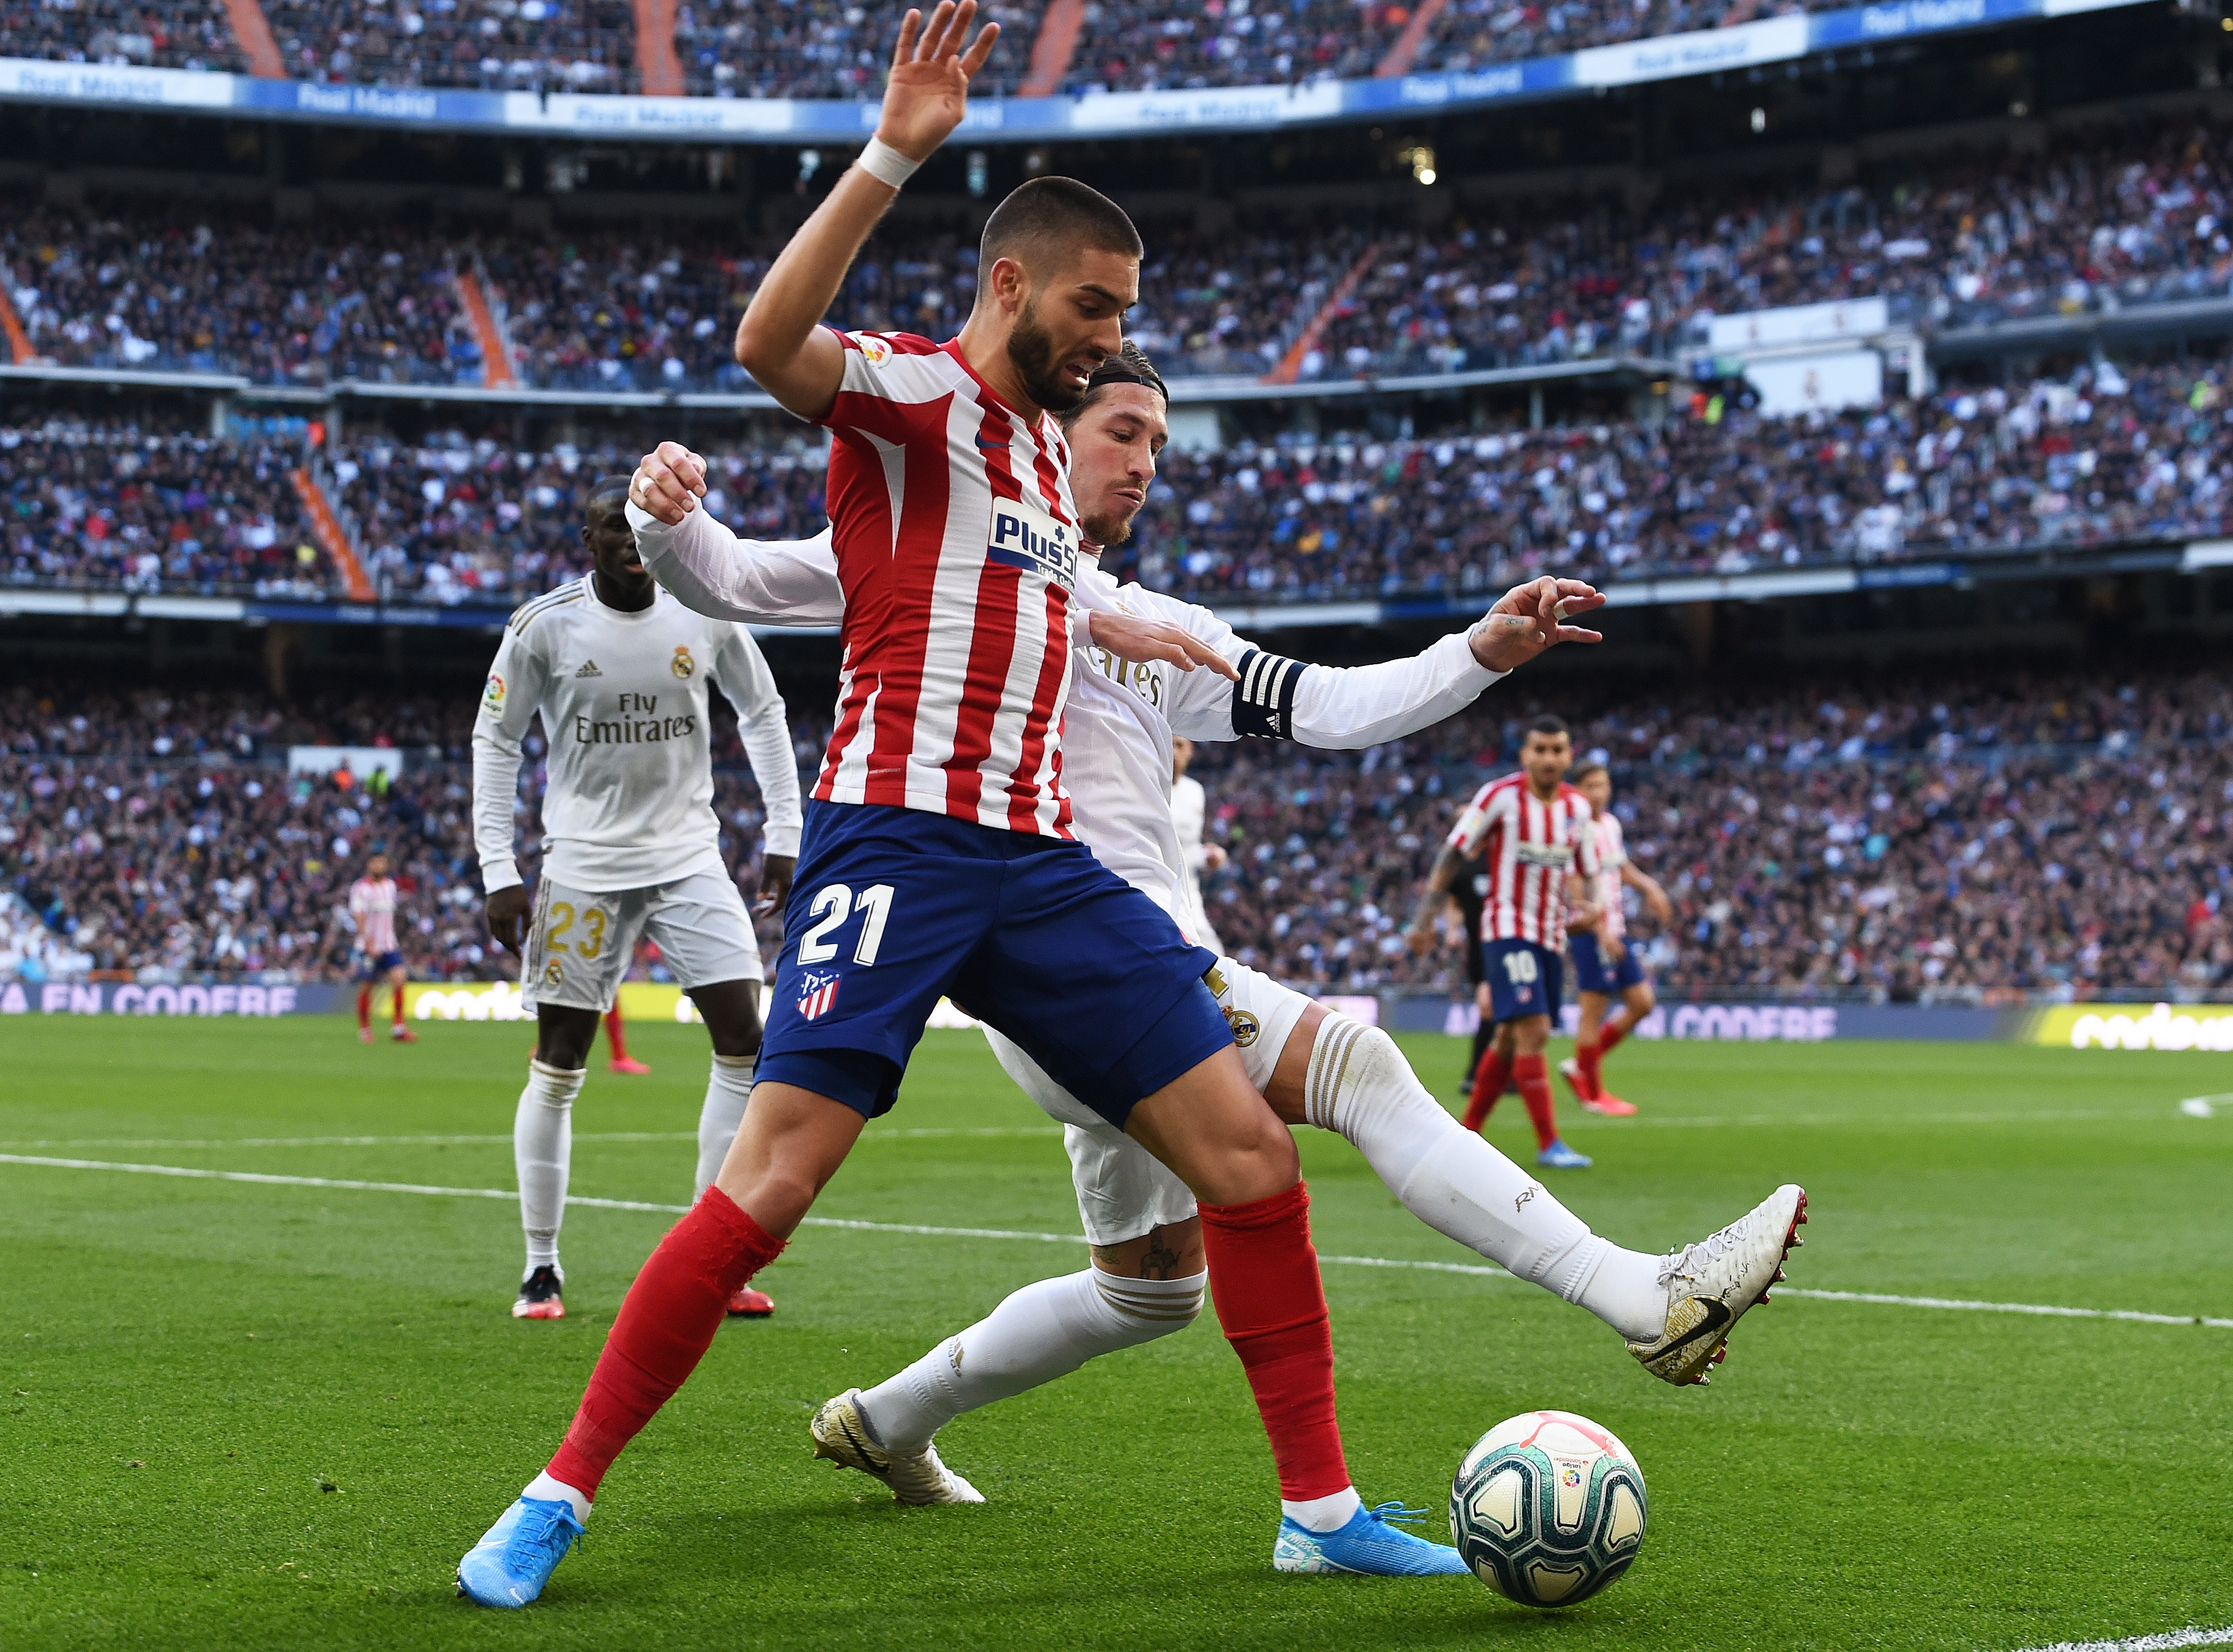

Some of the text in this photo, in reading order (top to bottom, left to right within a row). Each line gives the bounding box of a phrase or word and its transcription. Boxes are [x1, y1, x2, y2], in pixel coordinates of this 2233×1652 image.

[1036, 561, 1058, 583] Trade
[618, 692, 658, 715] Fly
[576, 714, 696, 744] Emirates
[545, 901, 606, 959] 23
[797, 883, 895, 967] 21
[1502, 949, 1537, 984] 10
[41, 984, 102, 1016] EN
[113, 984, 298, 1017] CODERE
[1672, 1005, 1838, 1042] CODERE
